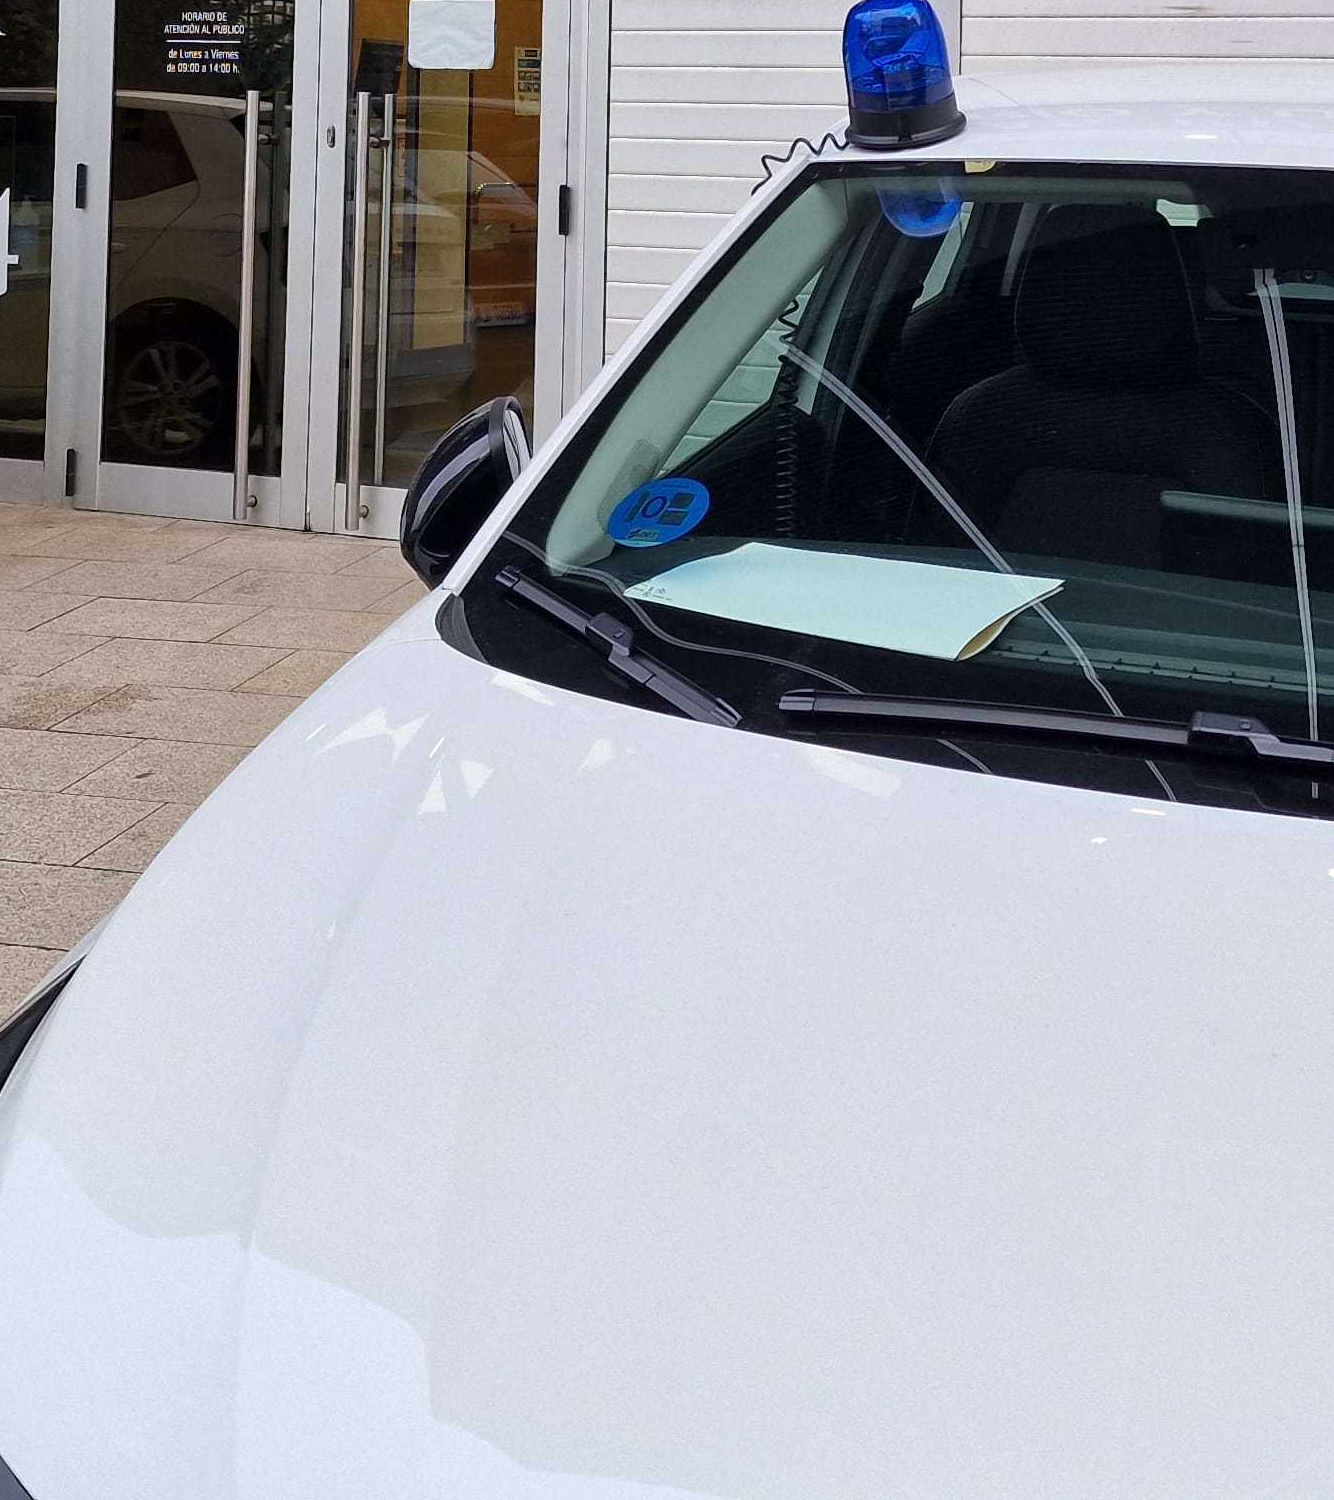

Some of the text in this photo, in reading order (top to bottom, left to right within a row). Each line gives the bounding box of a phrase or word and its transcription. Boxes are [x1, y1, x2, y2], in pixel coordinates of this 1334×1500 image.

[181, 11, 228, 22] HORARIO DE
[164, 23, 245, 35] ATENCIÓN AL PÚBLICO
[168, 49, 178, 59] de
[166, 62, 176, 73] de
[177, 62, 200, 73] 09:00
[201, 64, 207, 73] a
[209, 62, 231, 74] 14:00
